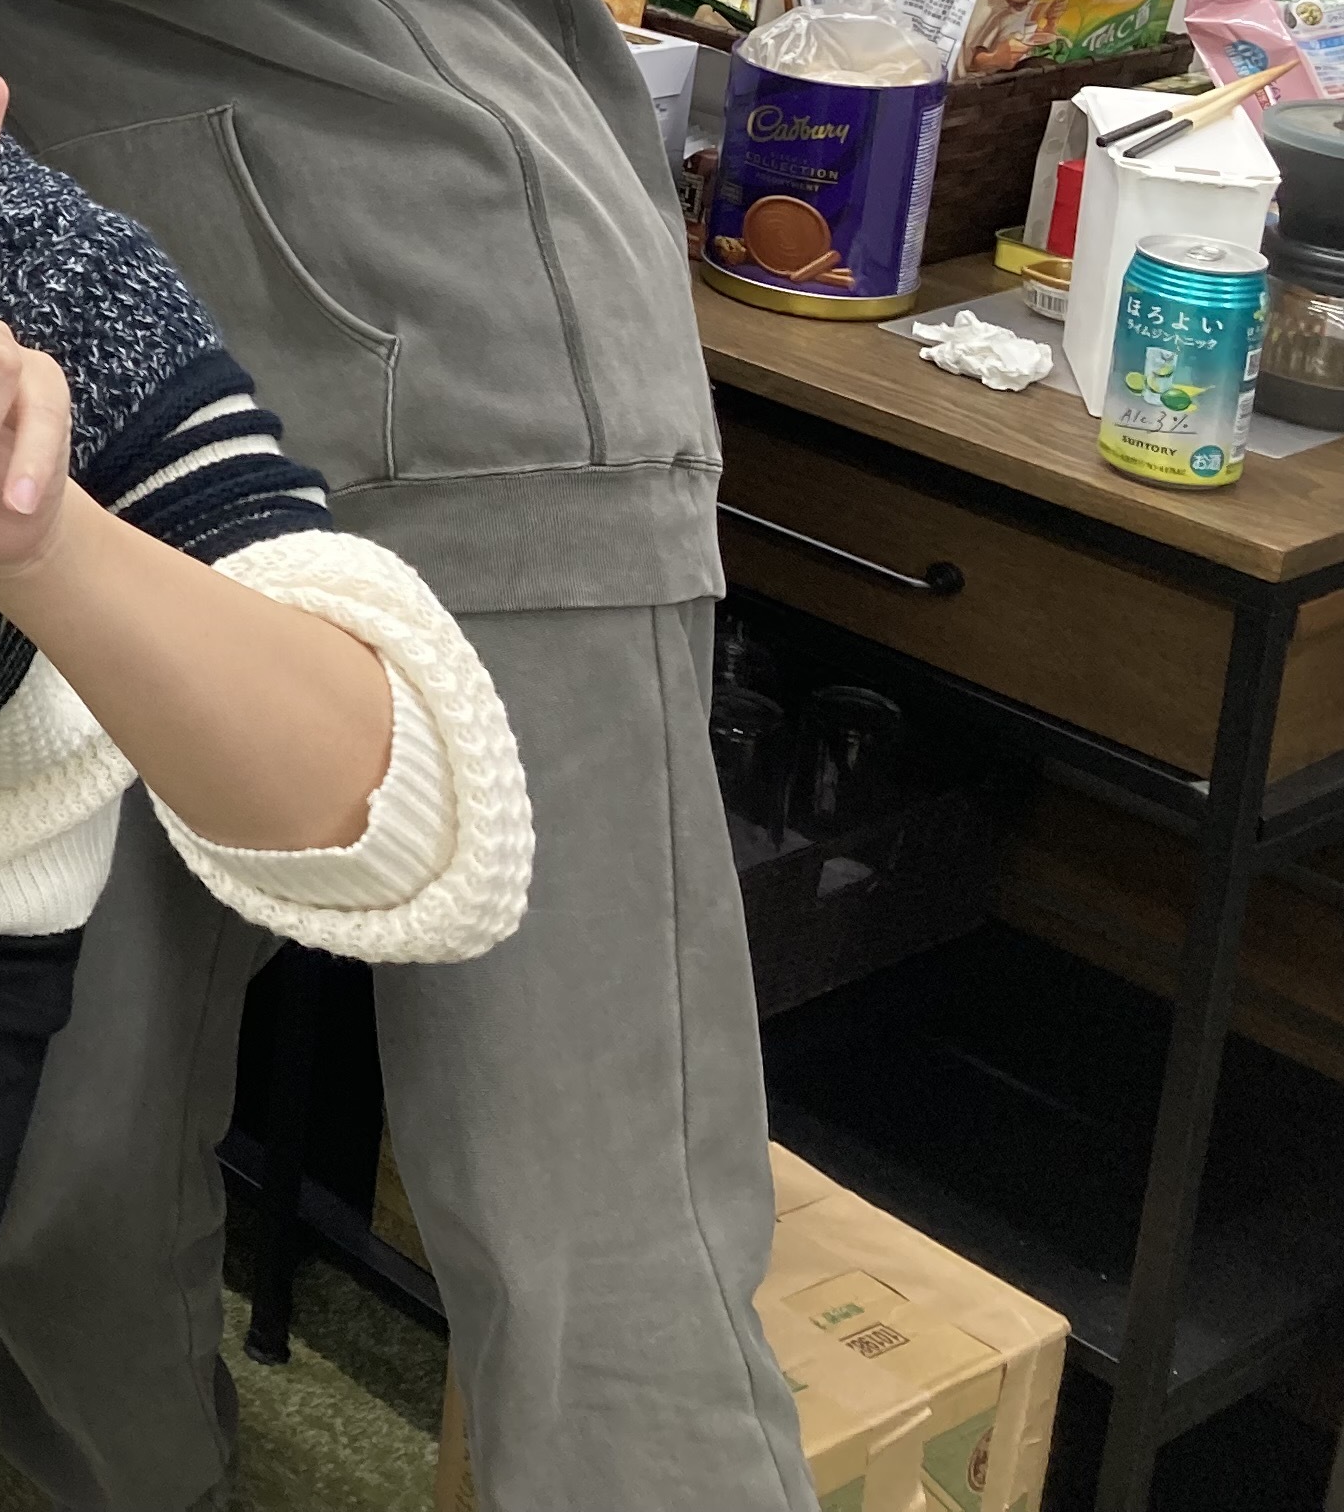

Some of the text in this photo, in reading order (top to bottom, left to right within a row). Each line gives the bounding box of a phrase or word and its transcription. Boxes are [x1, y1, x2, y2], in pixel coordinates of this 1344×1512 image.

[747, 104, 851, 144] Cadbury
[746, 151, 839, 180] COLLECTION
[1127, 296, 1223, 334] ほろよい
